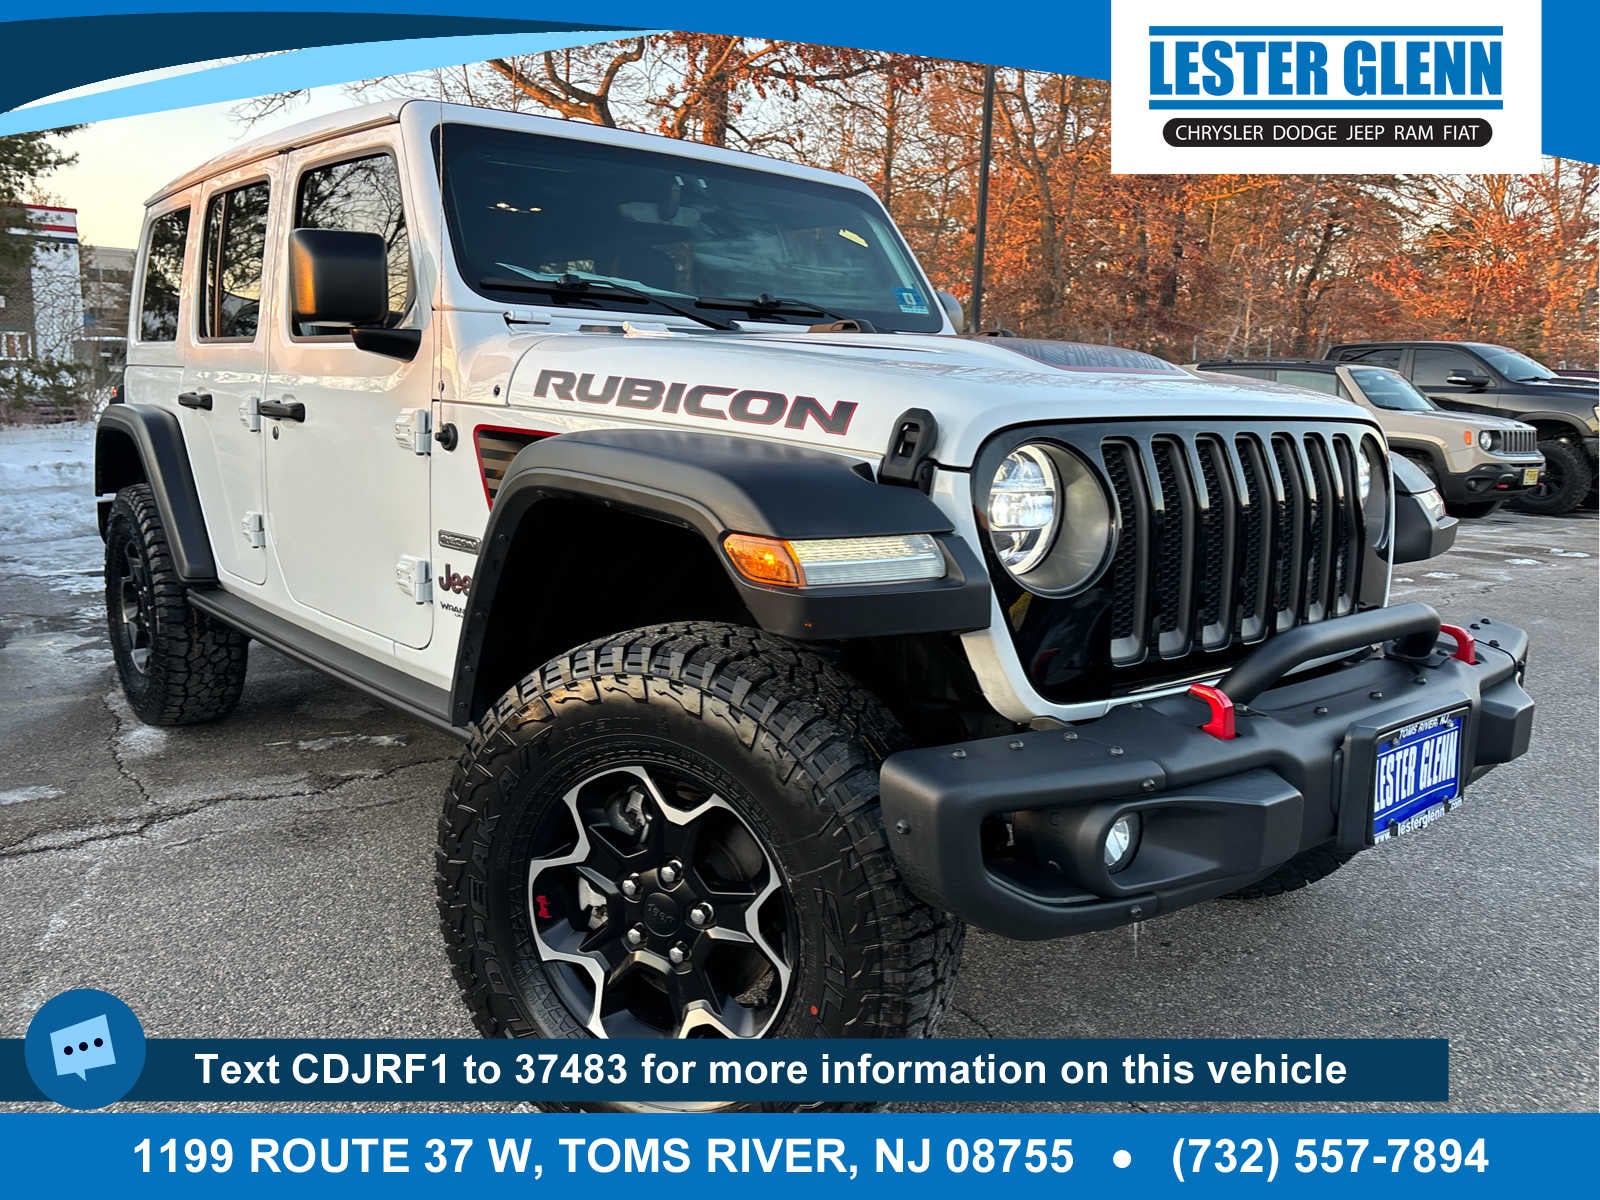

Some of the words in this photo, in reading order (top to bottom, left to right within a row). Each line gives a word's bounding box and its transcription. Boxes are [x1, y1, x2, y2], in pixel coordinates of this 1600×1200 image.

[533, 369, 859, 436] RUBICON
[438, 563, 472, 597] Jee
[1374, 745, 1418, 813] LESTER
[1419, 730, 1459, 791] GLENN
